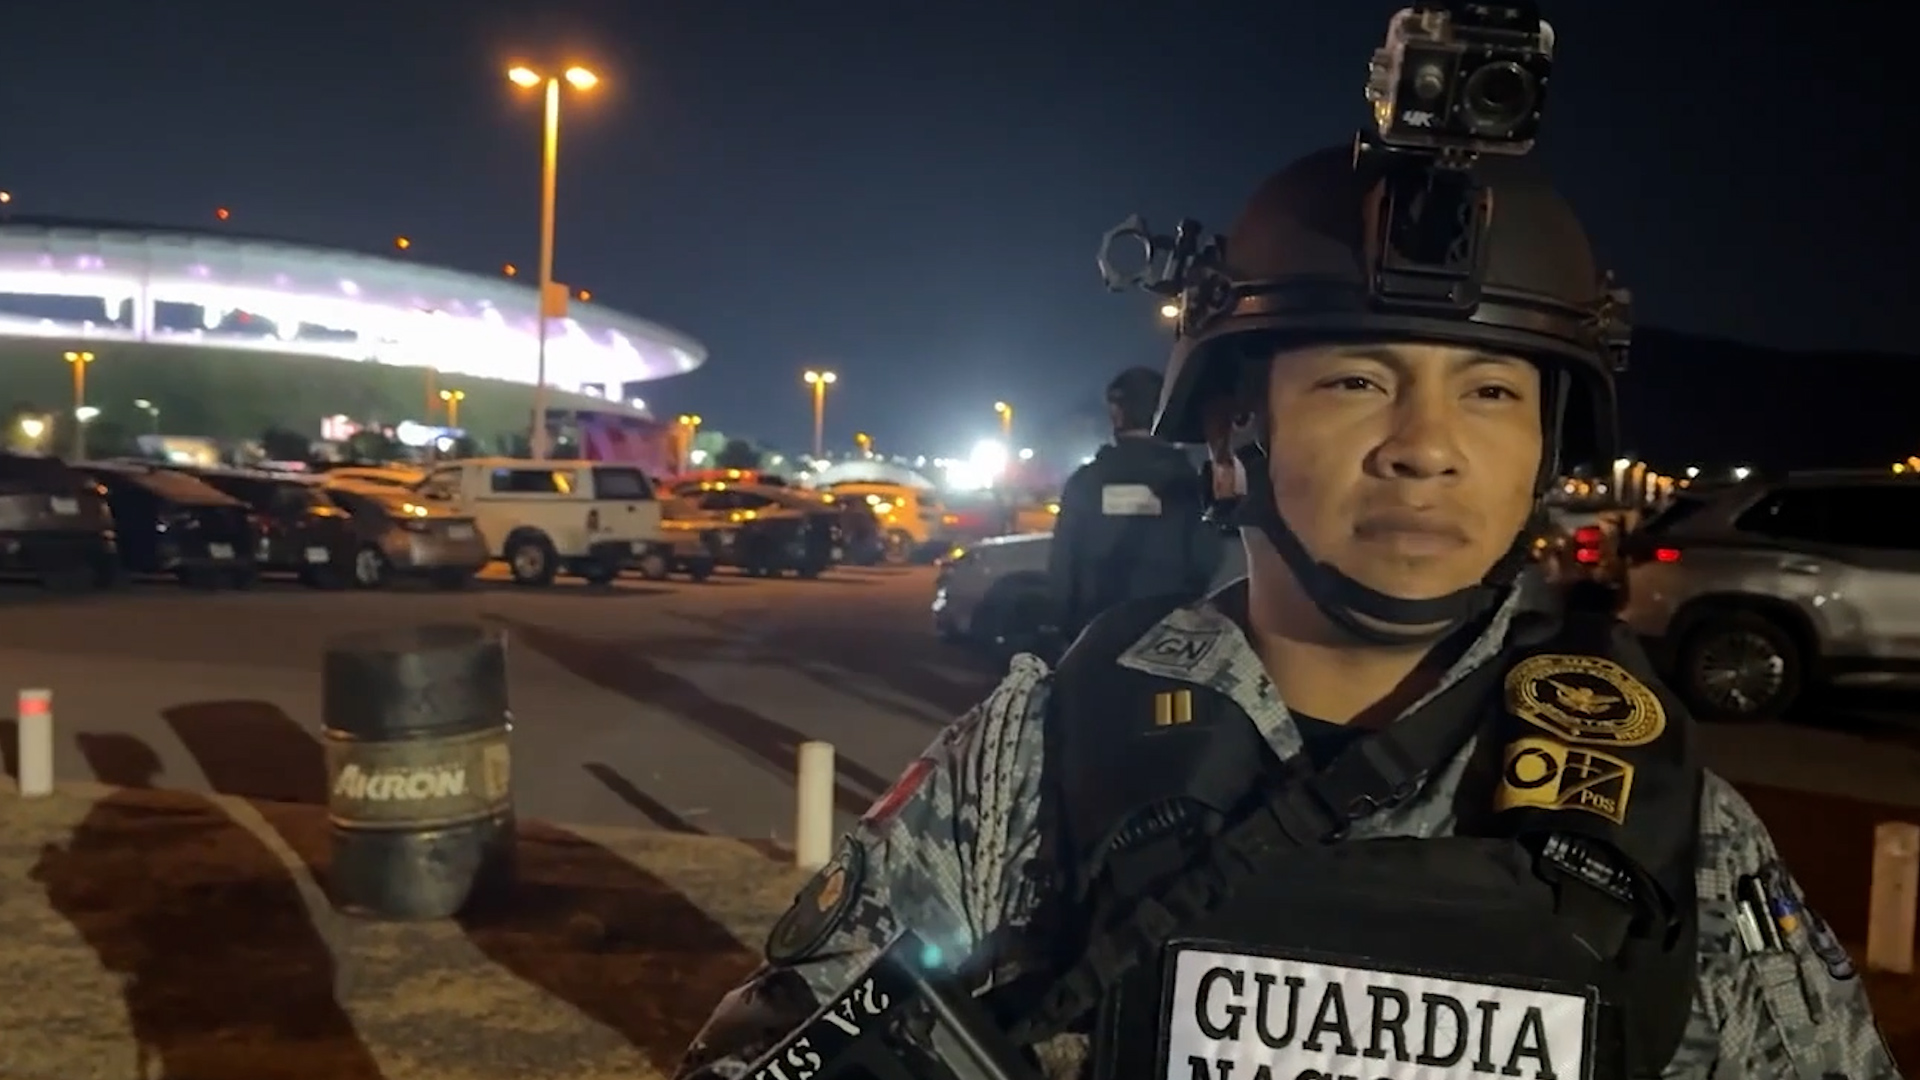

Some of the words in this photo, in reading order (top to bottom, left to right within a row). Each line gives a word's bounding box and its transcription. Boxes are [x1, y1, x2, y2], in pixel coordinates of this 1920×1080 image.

[1402, 110, 1434, 128] 4K
[1154, 637, 1207, 660] GN
[333, 764, 467, 801] AKRON
[1580, 788, 1616, 814] POS
[1195, 966, 1558, 1080] GUARDIA
